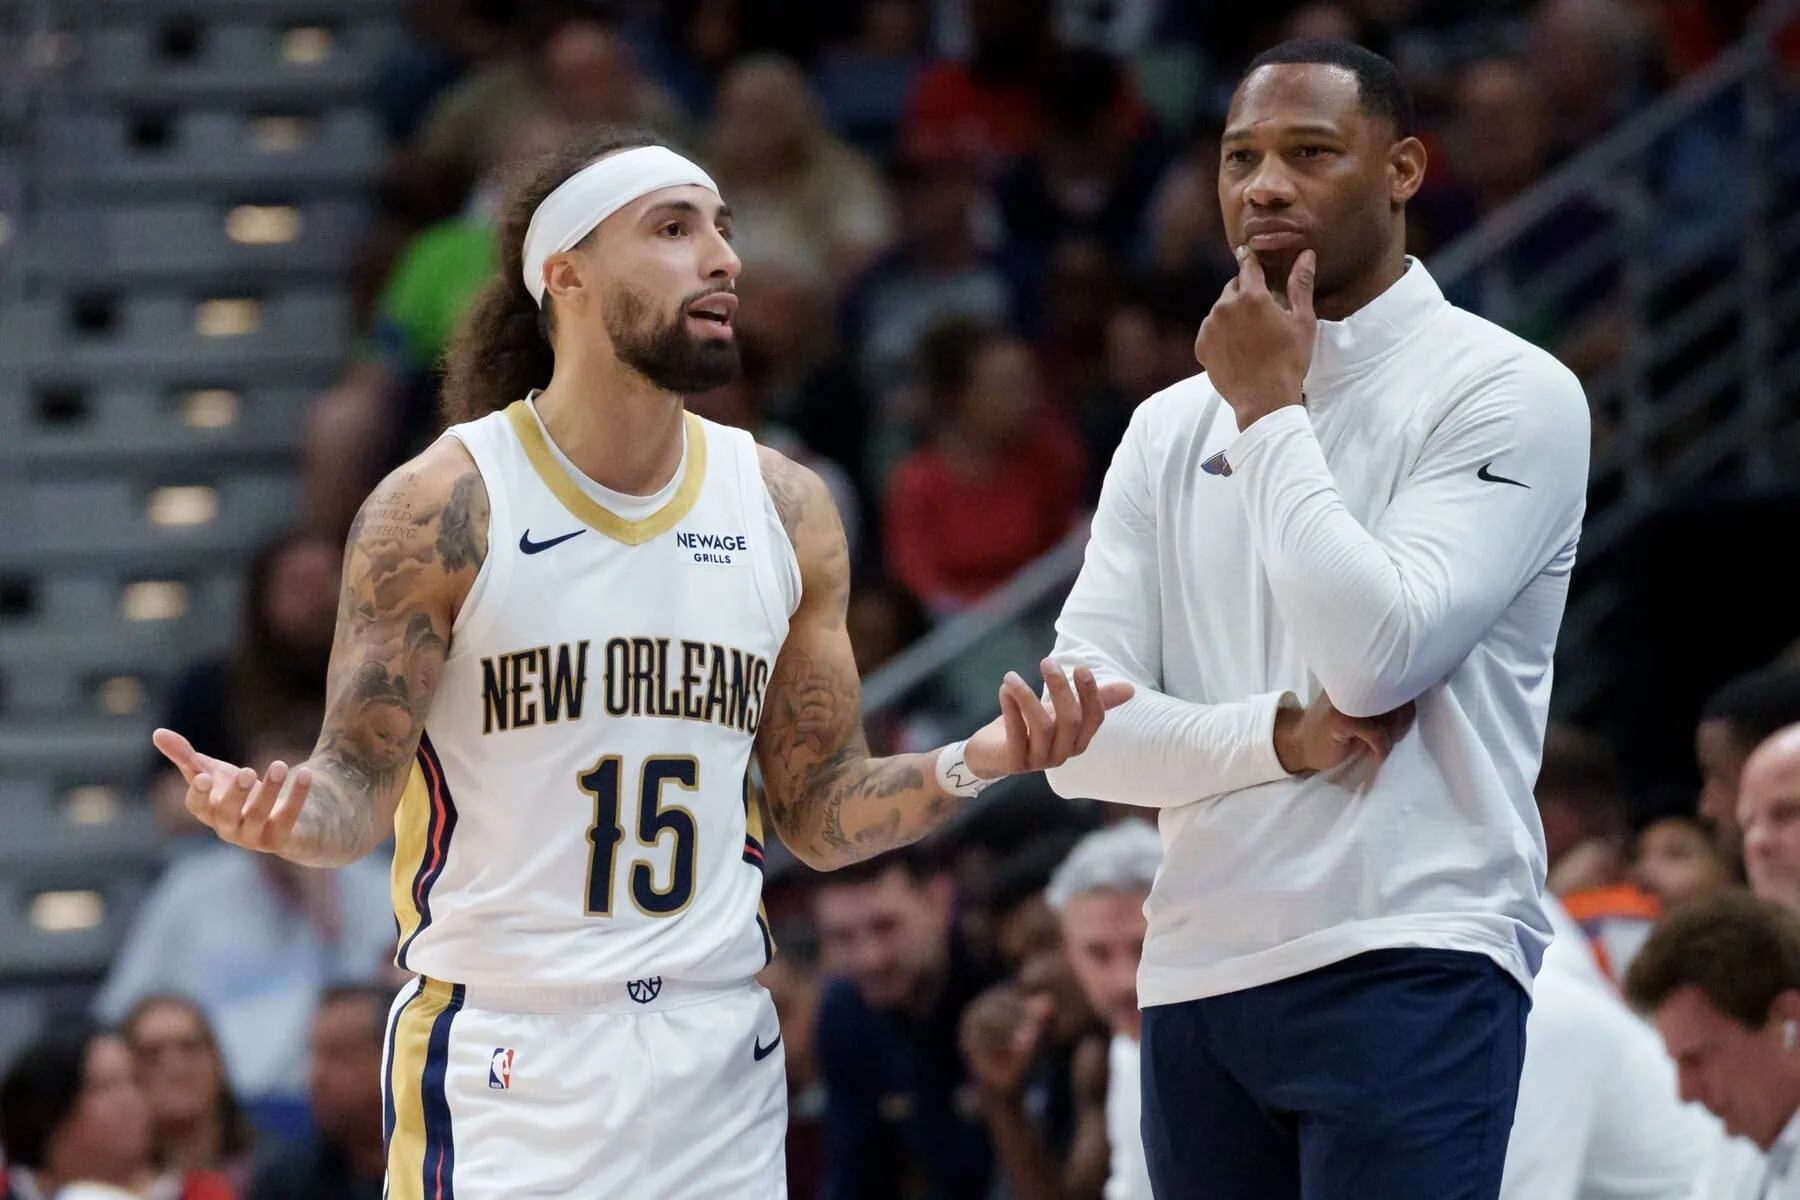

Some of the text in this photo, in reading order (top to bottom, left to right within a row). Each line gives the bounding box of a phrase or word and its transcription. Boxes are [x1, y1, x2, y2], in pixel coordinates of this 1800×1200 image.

[676, 532, 747, 551] NEWAGE
[693, 553, 732, 564] GRILLS
[480, 636, 768, 737] NEW ORLEANS
[577, 754, 700, 918] 15
